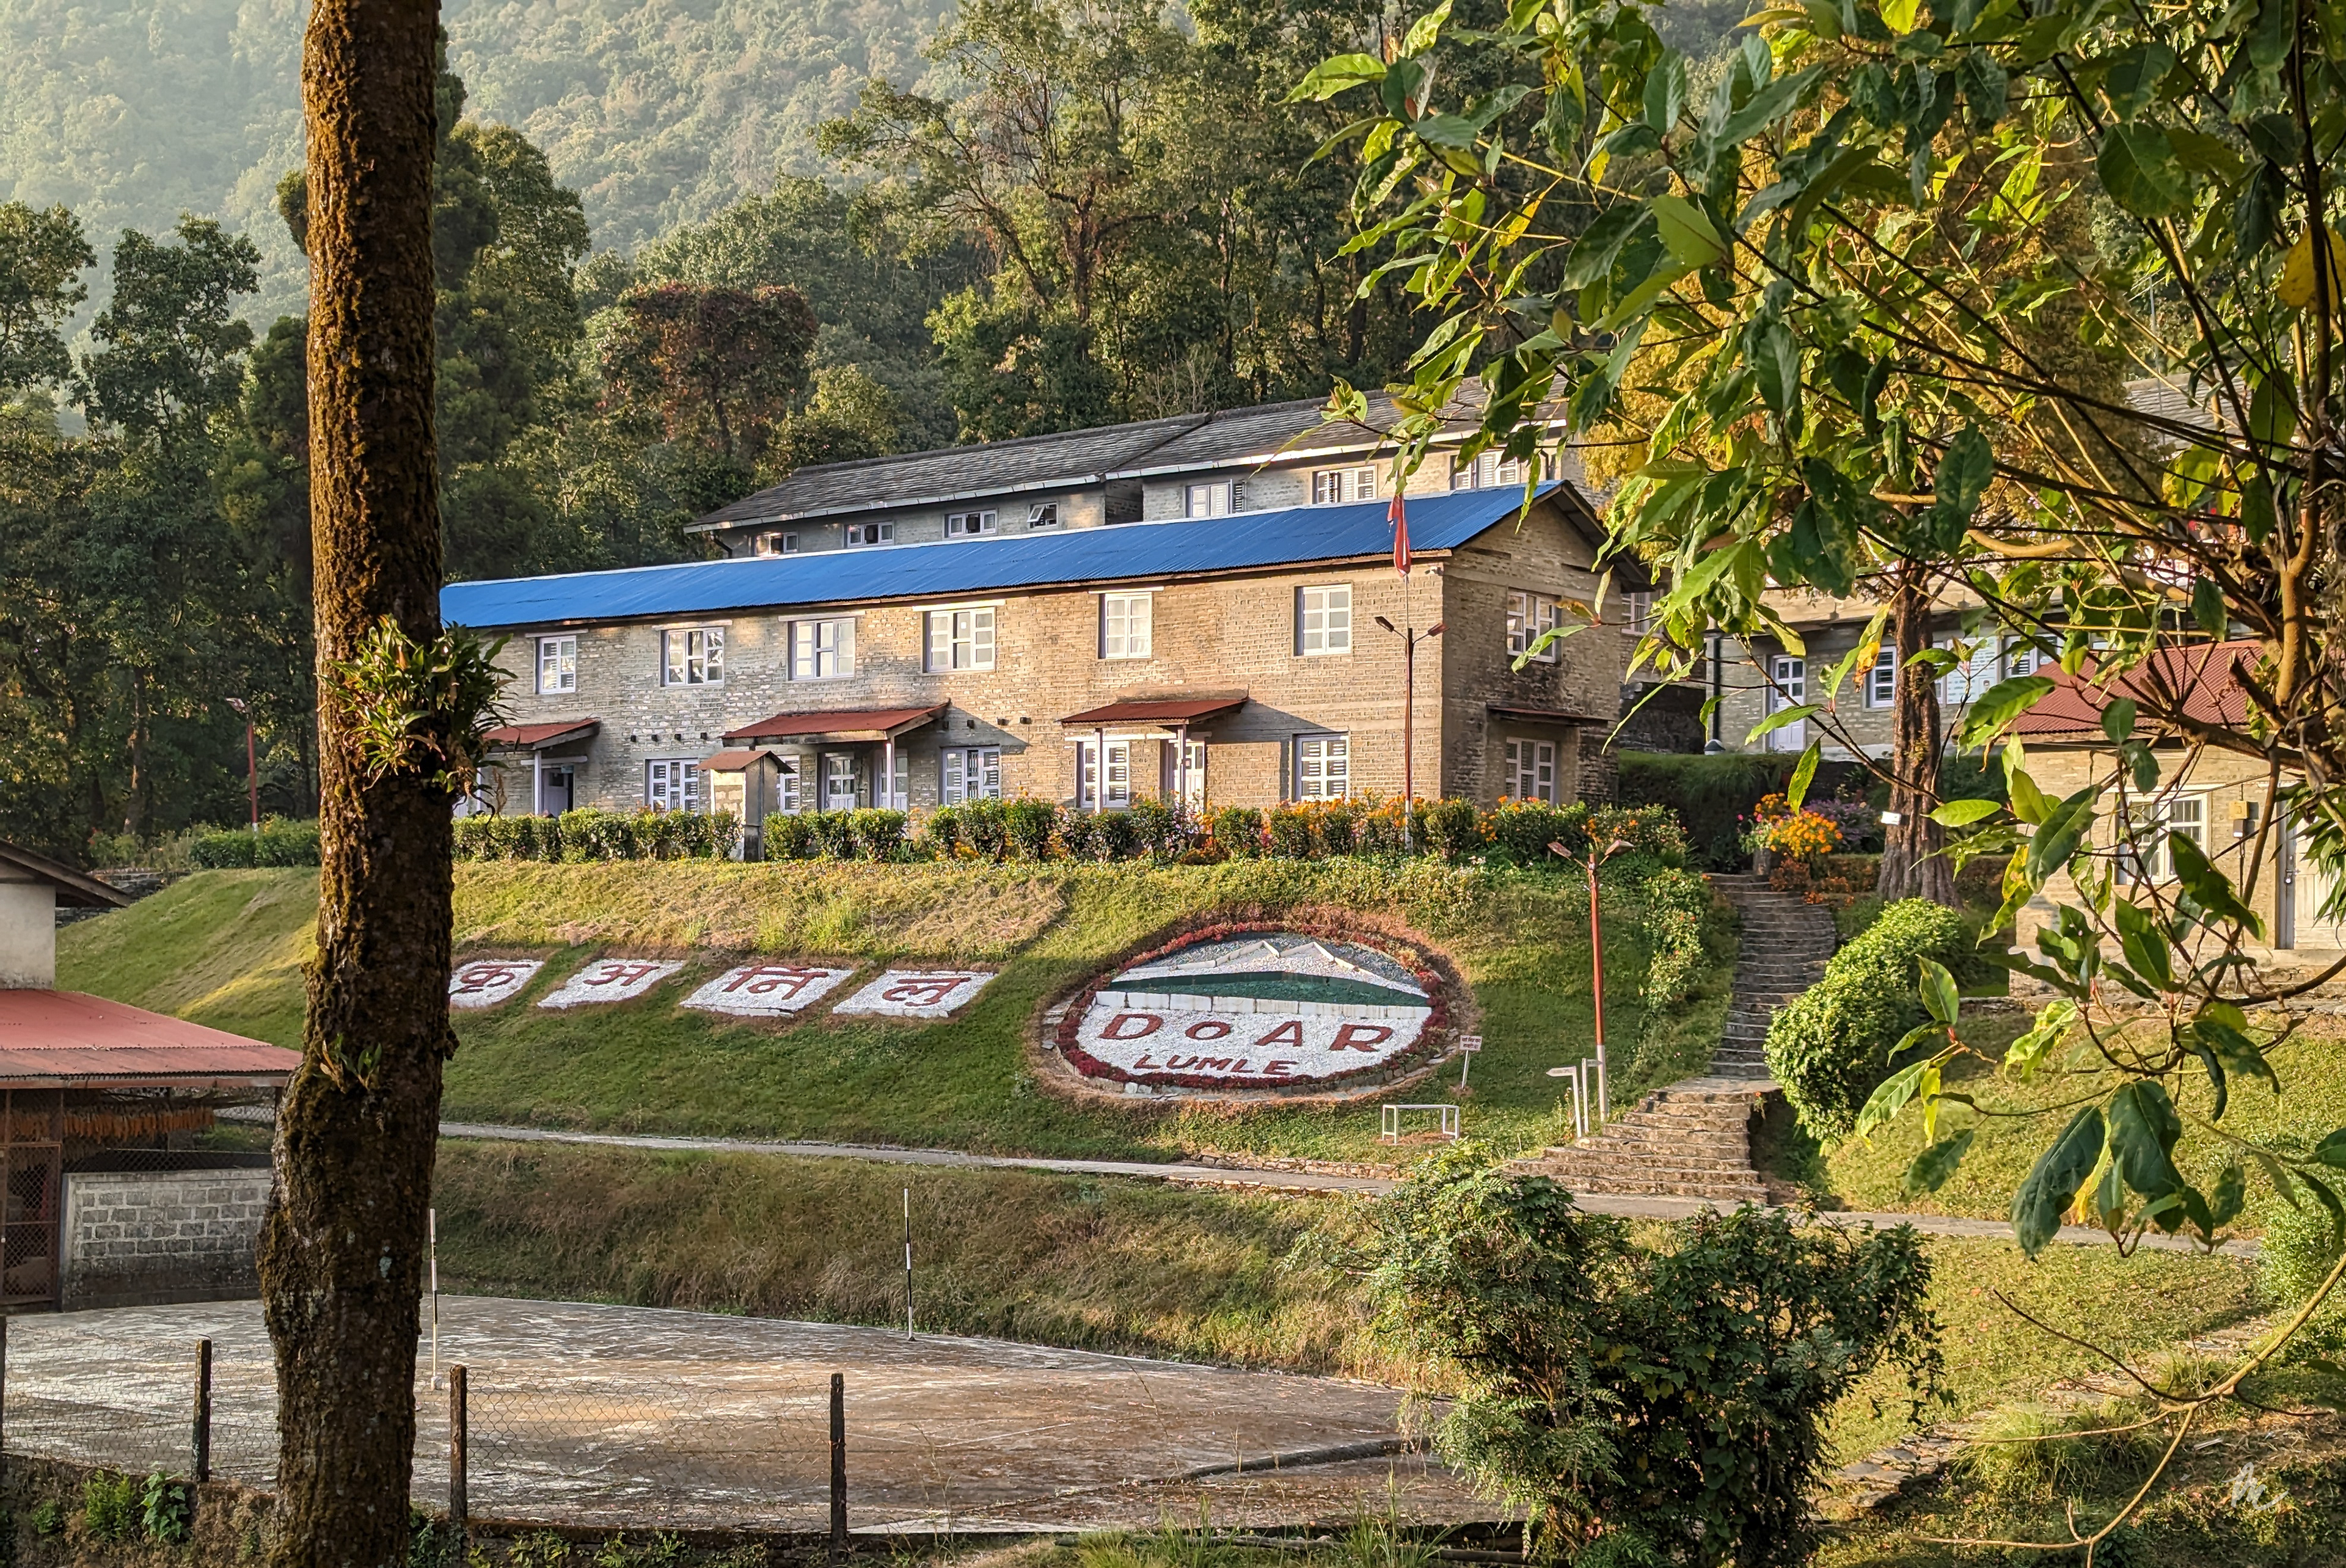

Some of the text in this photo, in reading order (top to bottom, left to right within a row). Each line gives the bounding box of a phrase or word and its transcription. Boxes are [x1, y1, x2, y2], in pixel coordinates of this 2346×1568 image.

[583, 964, 660, 986] अ
[722, 964, 829, 1000] नि
[1133, 1054, 1300, 1076] LUMLE
